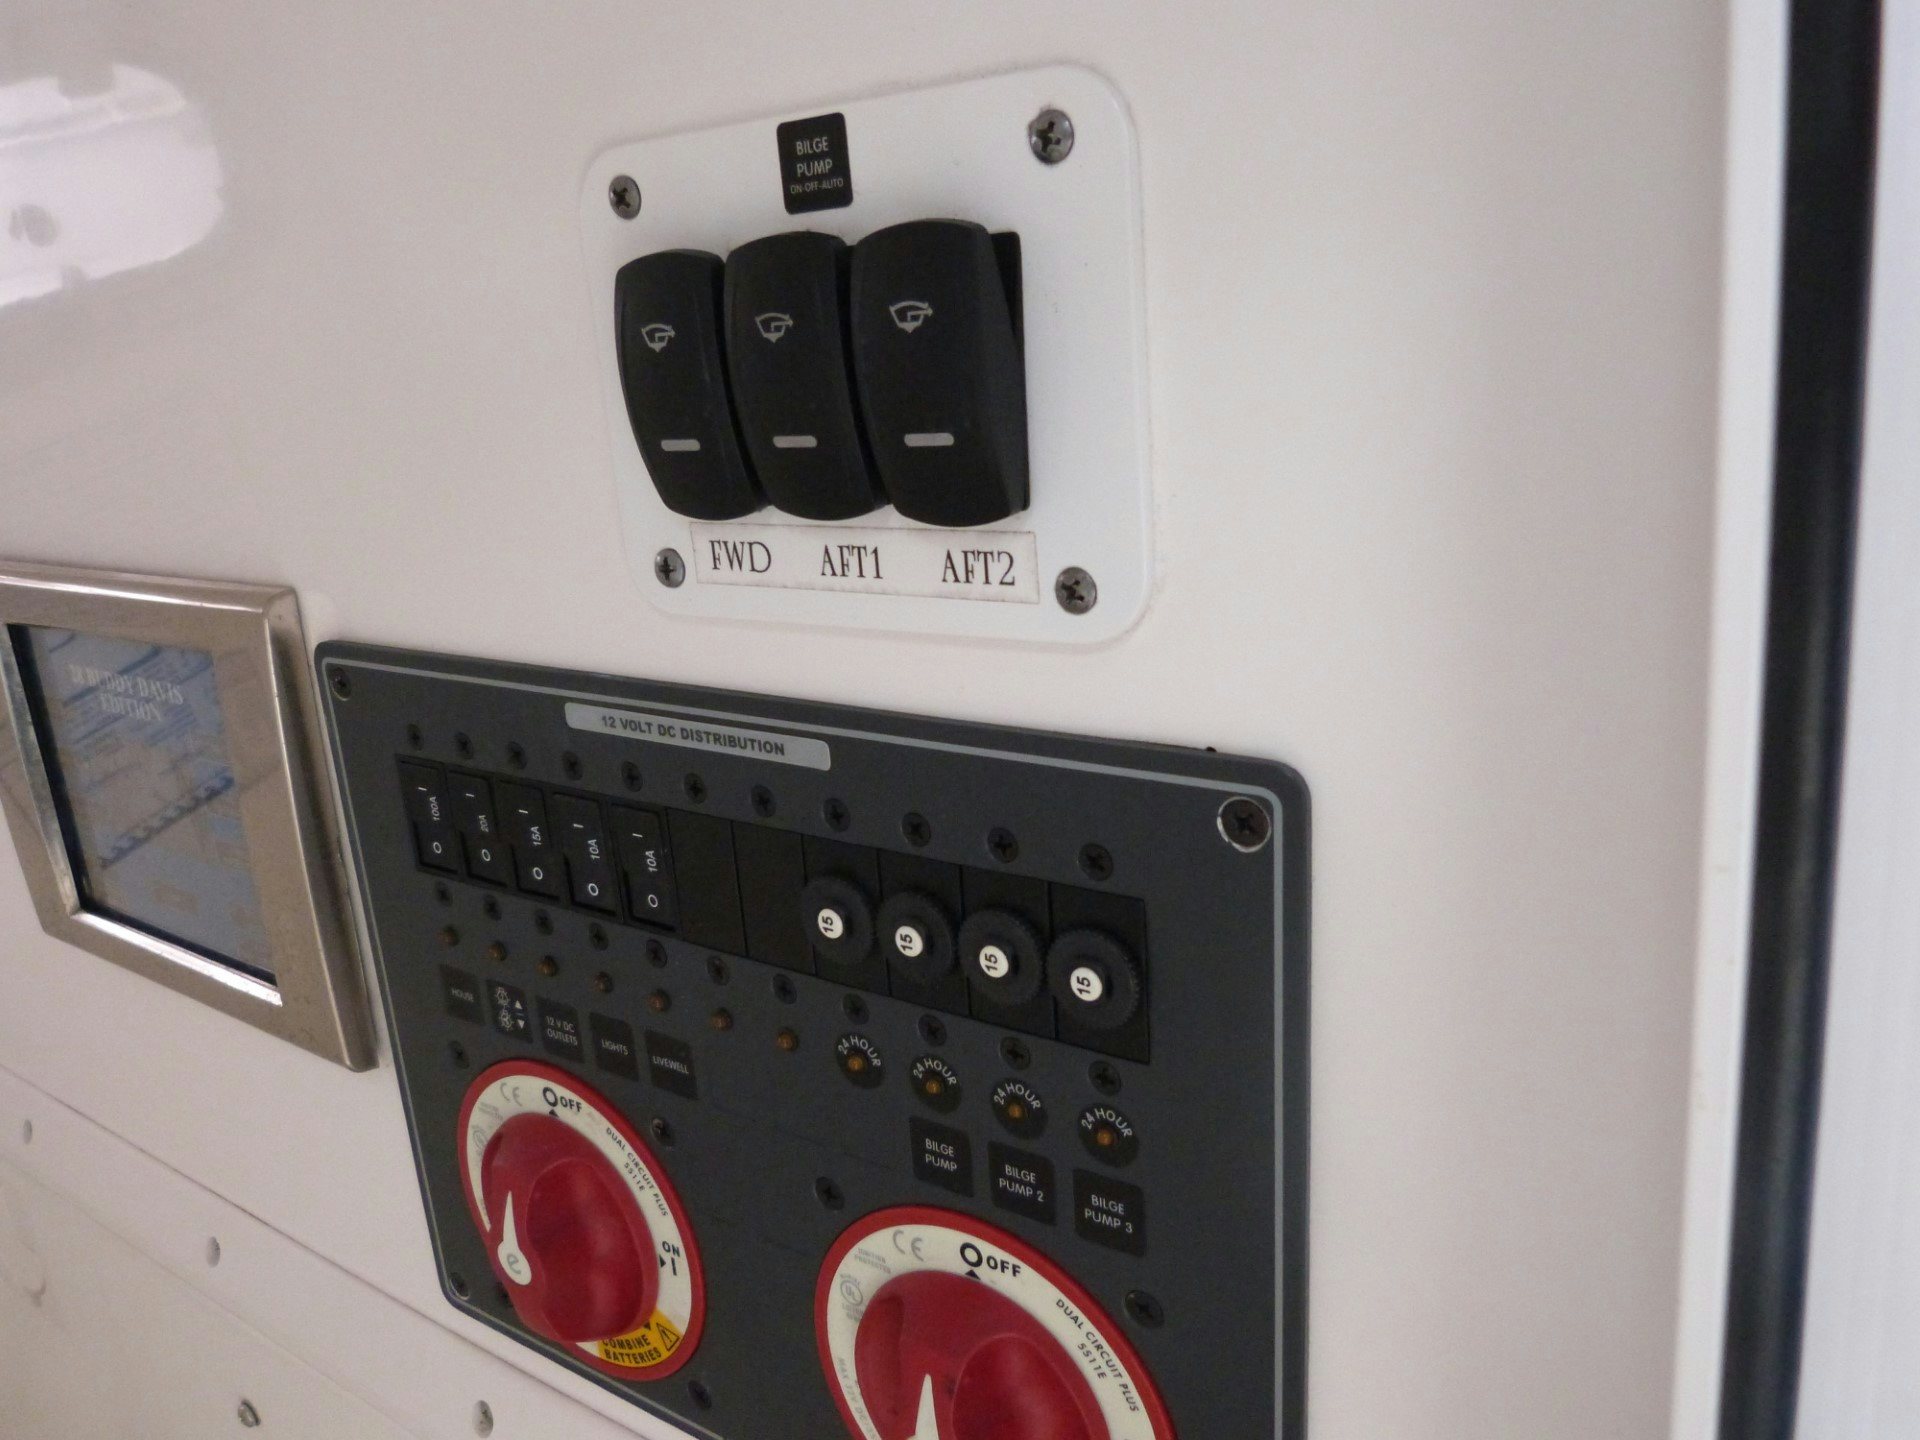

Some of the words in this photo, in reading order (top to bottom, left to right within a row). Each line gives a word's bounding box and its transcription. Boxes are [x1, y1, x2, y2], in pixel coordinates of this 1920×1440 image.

[796, 137, 828, 155] BILGE
[797, 159, 832, 177] PUMP
[709, 540, 771, 573] FWD
[821, 545, 883, 579] AFT1
[942, 549, 1015, 586] AFT2
[602, 715, 616, 728] 12
[620, 718, 653, 734] VOLT
[658, 724, 676, 738] DC
[681, 729, 785, 755] DISTRIBUTION
[588, 839, 600, 859] 10A
[645, 850, 658, 873] 10A
[822, 916, 834, 933] 15
[900, 934, 913, 952] 15
[985, 953, 998, 972] 15
[1077, 976, 1091, 996] 15
[601, 1039, 629, 1056] LIGHTS
[838, 1039, 850, 1055] 24
[850, 1035, 882, 1067] HOUR
[652, 1056, 689, 1075] LIVEWELL
[913, 1063, 924, 1079] 24
[923, 1057, 957, 1086] HOUR
[560, 1096, 583, 1113] OFF
[994, 1088, 1006, 1106] 24
[1005, 1082, 1042, 1110] HOUR
[1081, 1111, 1095, 1130] 24
[1094, 1107, 1133, 1138] HOUR
[925, 1138, 954, 1157] BILGE
[606, 1127, 626, 1151] DUAL
[627, 1152, 655, 1190] CIRCUIT
[653, 1193, 669, 1217] PLUS
[925, 1154, 957, 1172] PUMP
[1005, 1164, 1036, 1184] BILGE
[999, 1178, 1034, 1198] PUMP
[1036, 1190, 1044, 1202] 2
[1091, 1194, 1125, 1215] BILGE
[1084, 1208, 1121, 1229] PUMP
[1125, 1222, 1134, 1234] 3
[662, 1240, 680, 1258] ON
[986, 1255, 1022, 1278] OFF
[604, 1346, 661, 1364] BATTERIES
[1056, 1299, 1085, 1330] DUAL
[1086, 1331, 1123, 1380] CIRCUIT
[1119, 1382, 1139, 1412] PLUS
